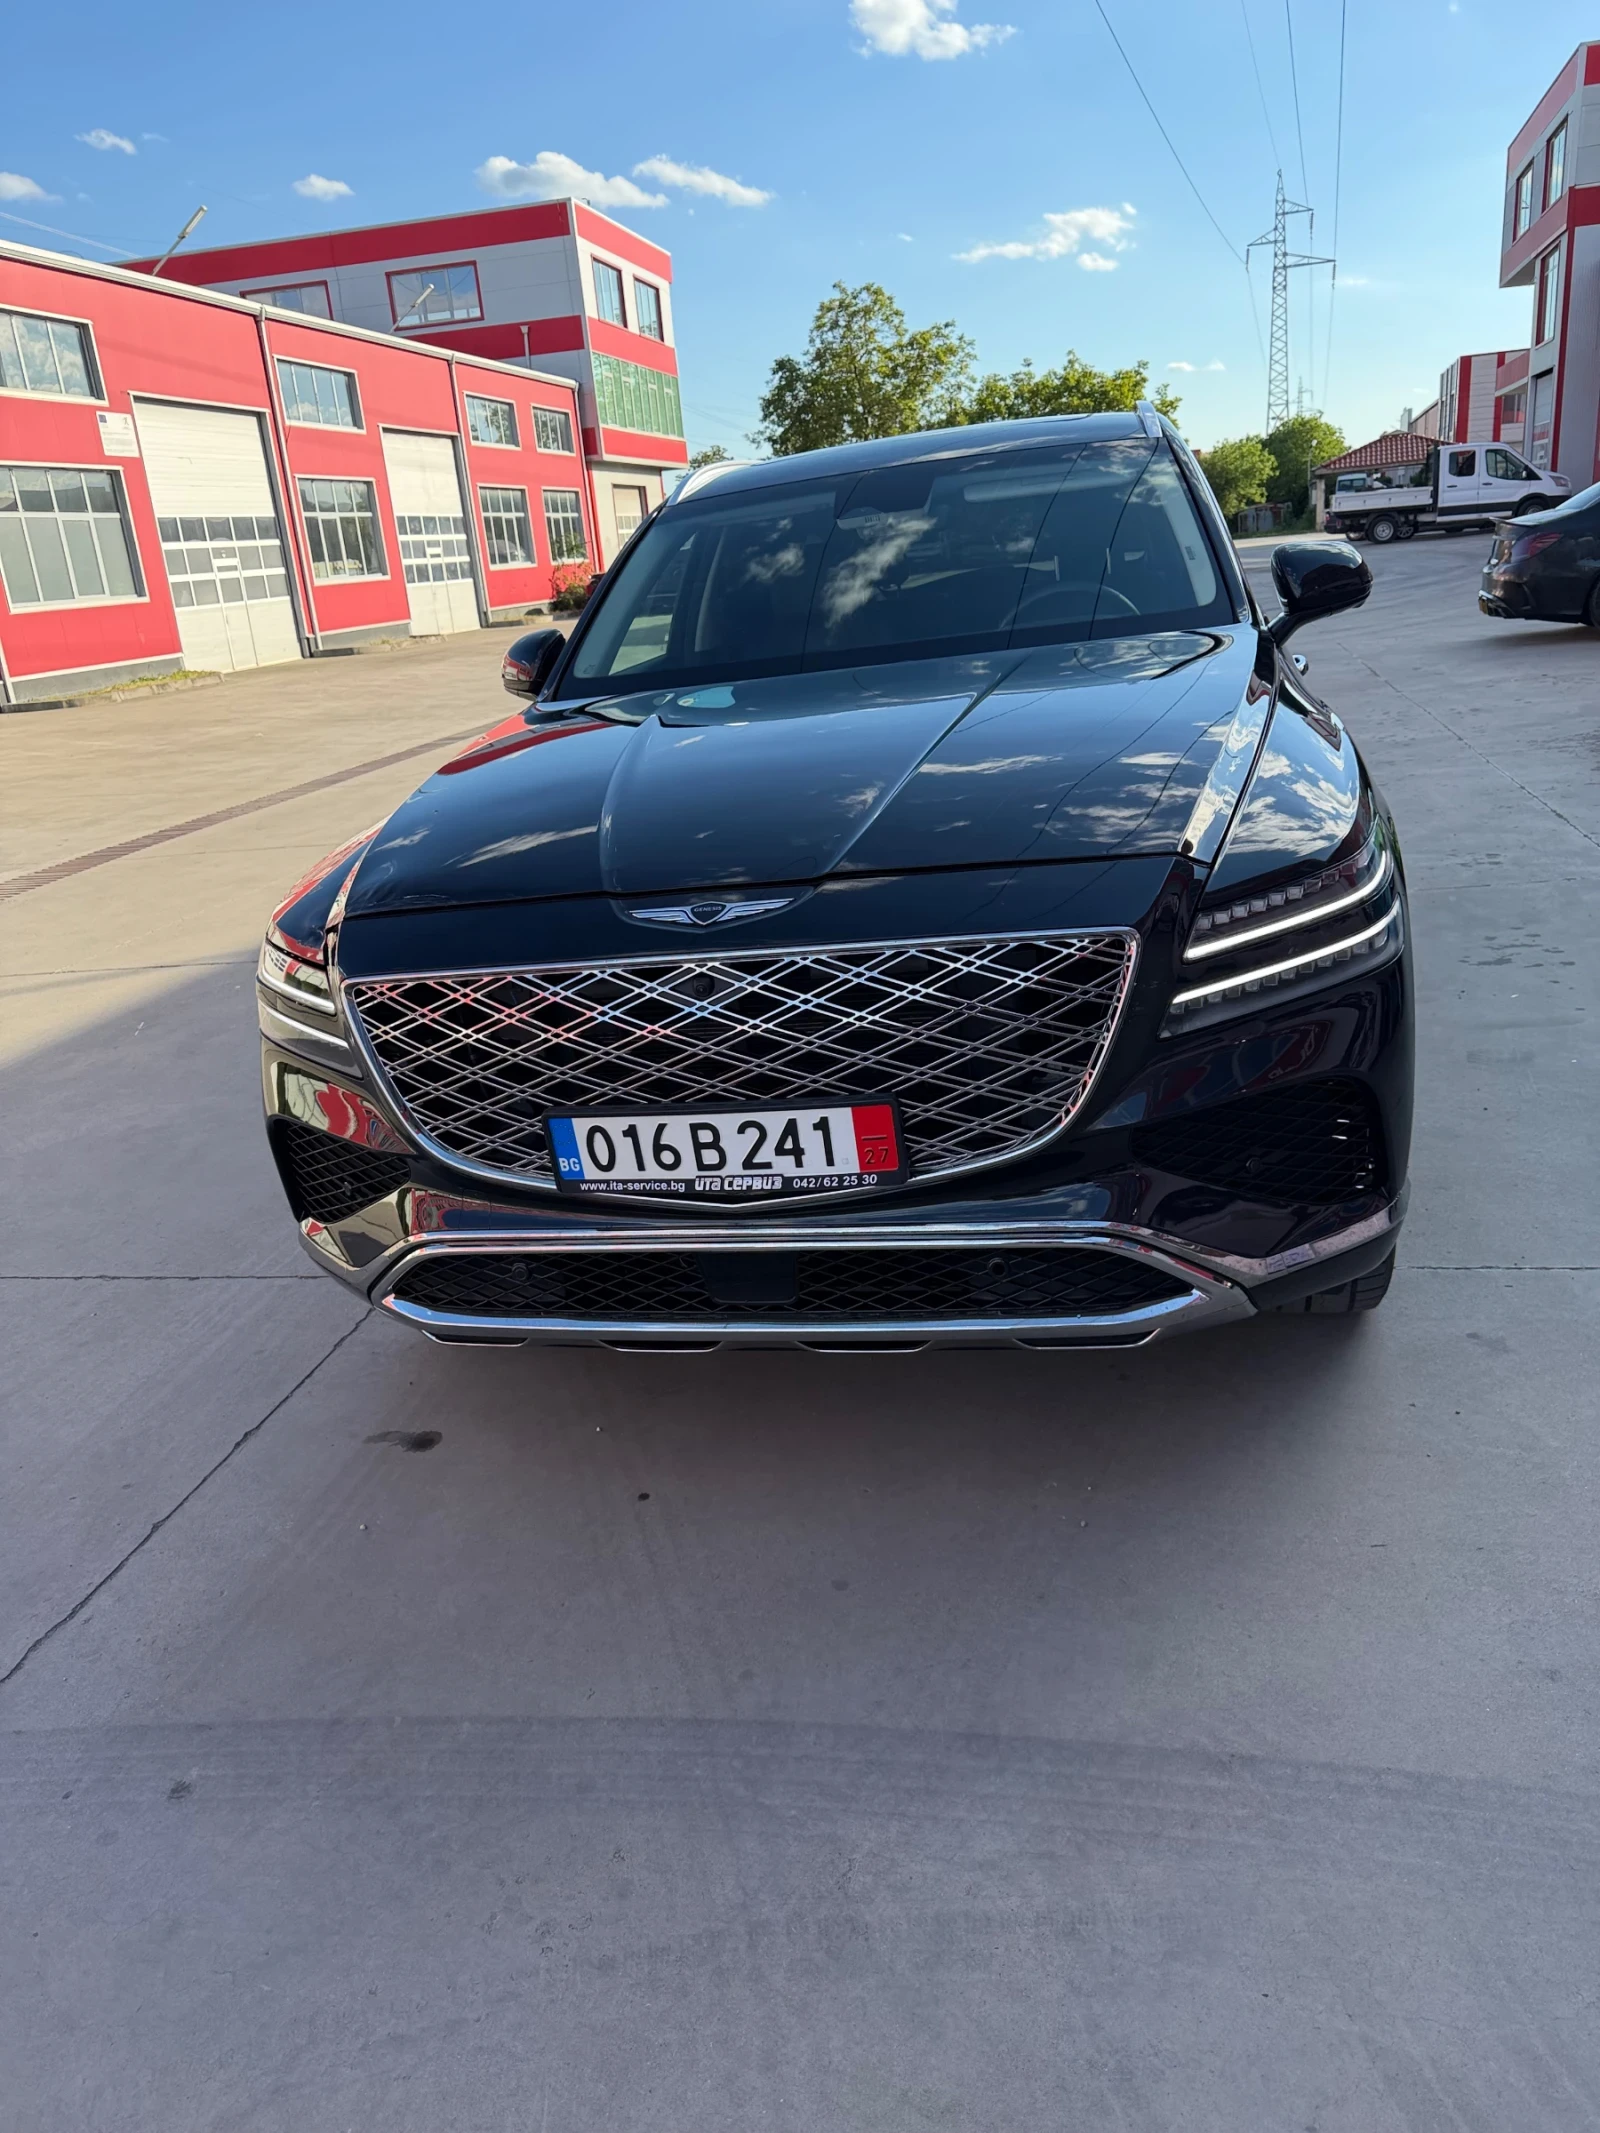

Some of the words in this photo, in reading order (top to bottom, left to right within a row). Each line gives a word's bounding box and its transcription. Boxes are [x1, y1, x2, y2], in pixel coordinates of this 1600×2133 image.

[864, 1146, 889, 1165] 27
[558, 1157, 580, 1172] BG
[580, 1180, 686, 1193] www.ita-service.bg
[843, 1175, 858, 1186] 25
[861, 1173, 878, 1185] 30
